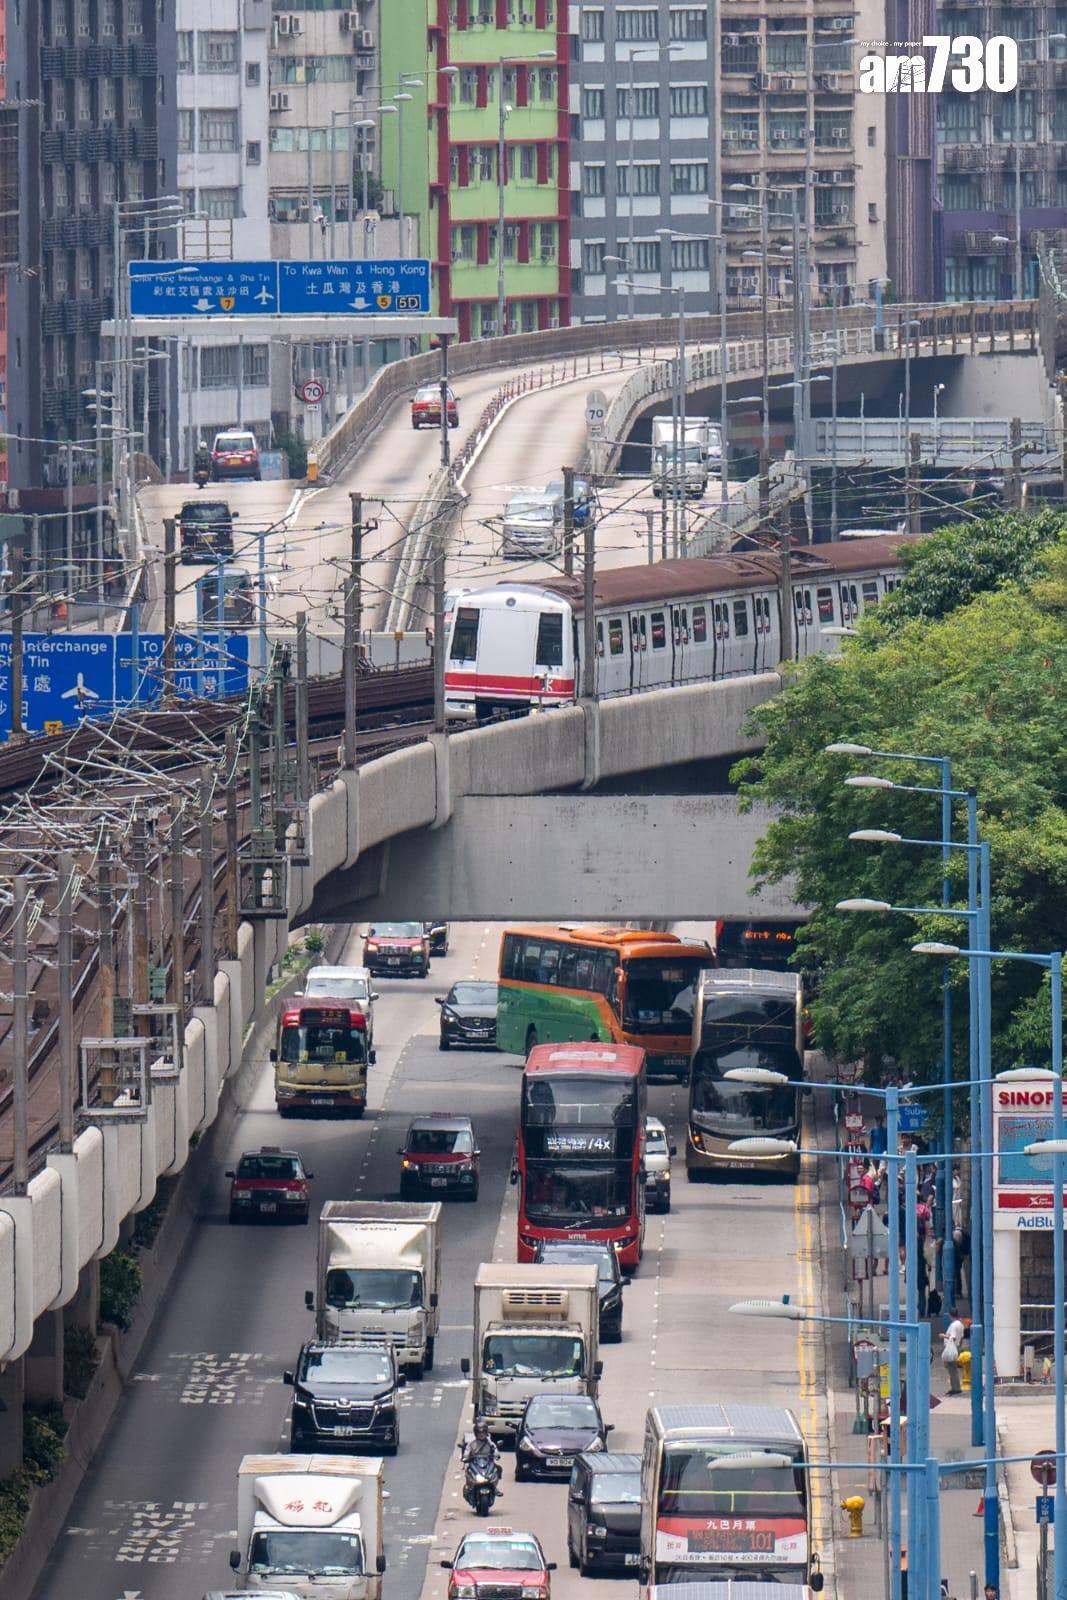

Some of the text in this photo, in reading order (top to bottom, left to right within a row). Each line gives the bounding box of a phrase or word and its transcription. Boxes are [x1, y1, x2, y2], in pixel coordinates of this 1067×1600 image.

[284, 264, 426, 276] To Kwa Wan & Hong Kong
[178, 274, 223, 283] Interchange
[240, 274, 255, 282] Sha
[258, 273, 270, 282] Tin
[306, 280, 400, 294] 土瓜灣及香港
[380, 297, 388, 307] 5
[306, 387, 321, 397] 70
[589, 409, 604, 420] 70
[22, 640, 107, 654] Interchange
[141, 641, 159, 653] To
[28, 655, 50, 667] Tin
[706, 1519, 757, 1530] 九巴月票
[750, 1532, 773, 1551] 101
